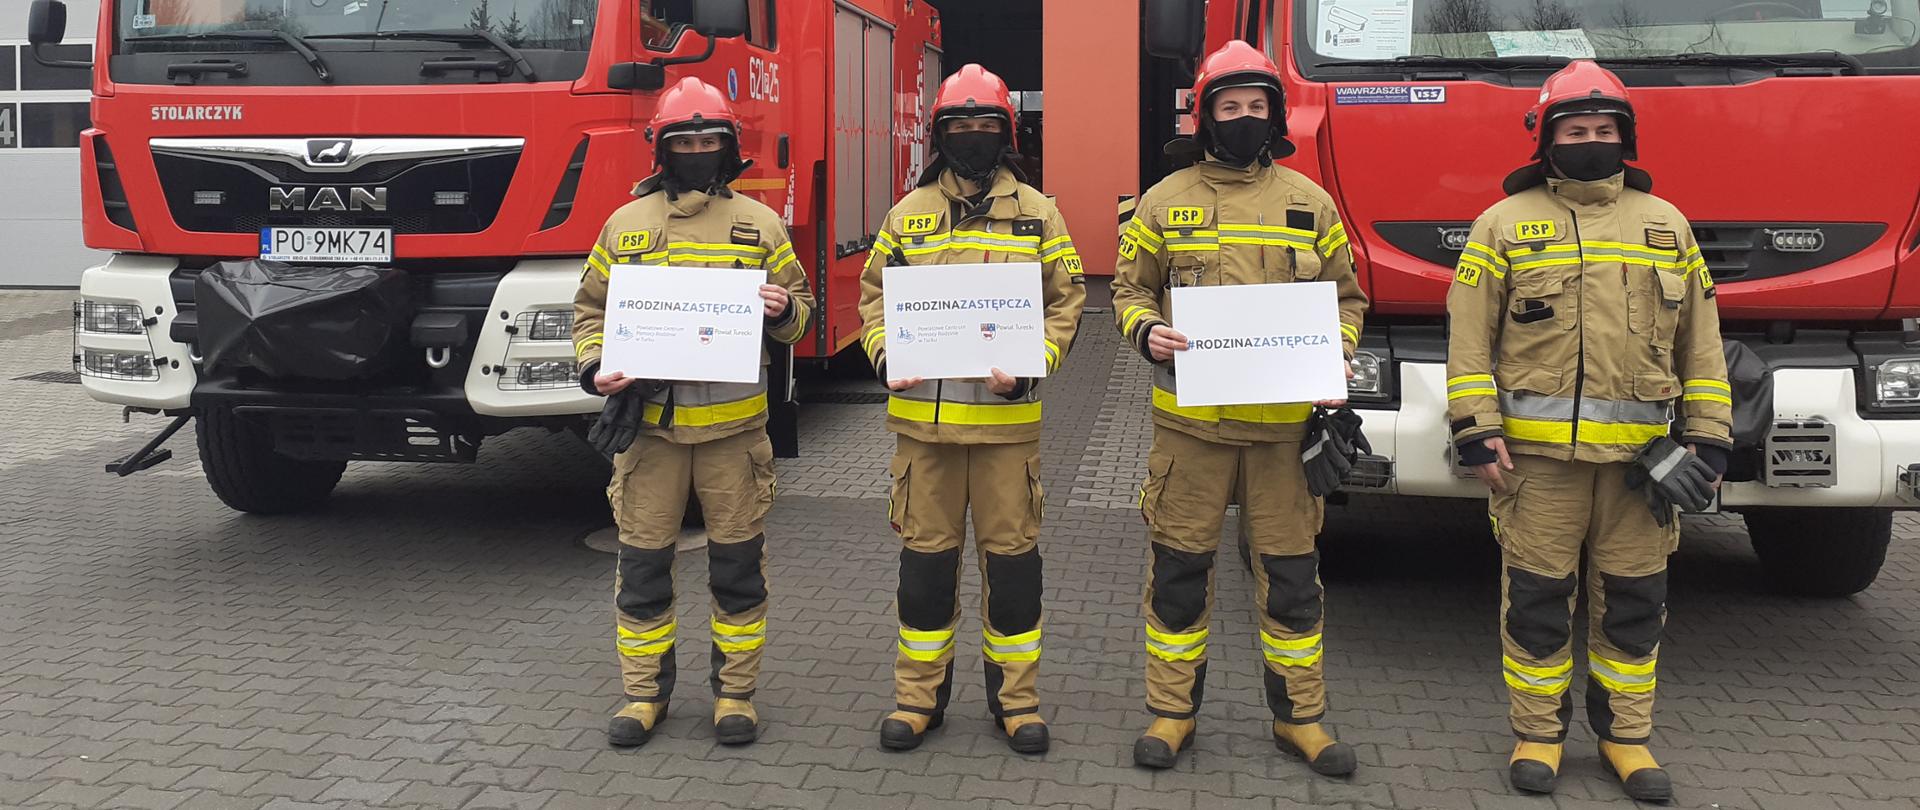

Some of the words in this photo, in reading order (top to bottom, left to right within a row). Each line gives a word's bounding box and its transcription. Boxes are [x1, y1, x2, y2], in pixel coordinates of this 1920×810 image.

[1336, 87, 1408, 95] WAWRZASZEK
[151, 106, 242, 120] STOLARCZYK
[269, 187, 387, 211] MAN
[1172, 210, 1198, 221] PSP
[908, 218, 931, 229] PSP
[1521, 223, 1549, 235] PSP
[276, 230, 305, 252] PO
[314, 230, 385, 253] 9MK74
[622, 234, 645, 246] PSP
[1458, 265, 1475, 281] PSP
[618, 299, 752, 315] #RODZINAZASTĘPCZA
[896, 298, 1032, 312] #RODZINAZASTĘPCZA
[1187, 334, 1330, 349] #RODZINAZASTĘPCZA
